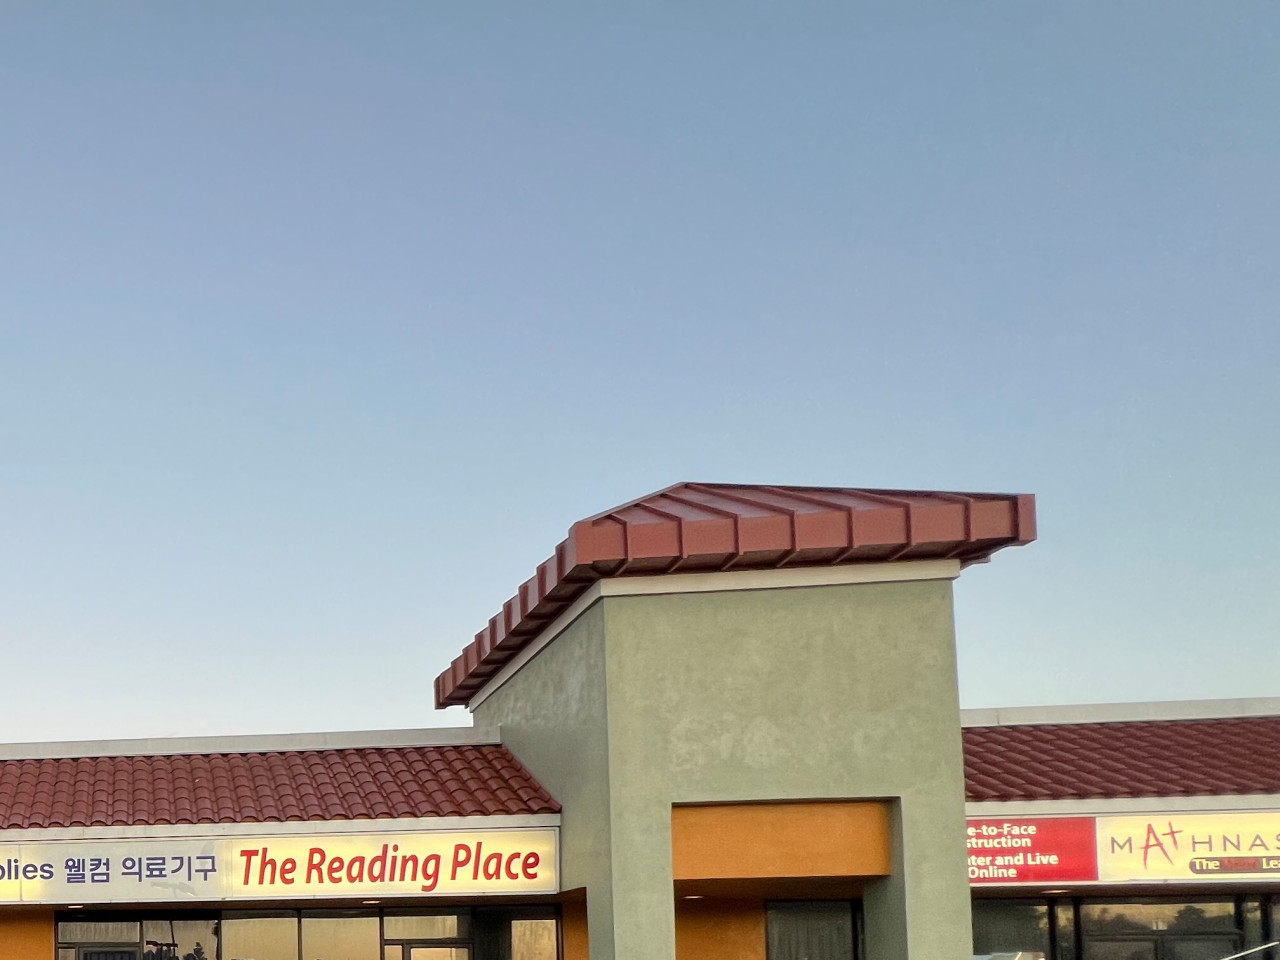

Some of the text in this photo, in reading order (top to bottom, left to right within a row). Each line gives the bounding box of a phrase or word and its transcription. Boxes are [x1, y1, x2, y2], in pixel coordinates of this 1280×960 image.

[995, 853, 1024, 865] and
[1027, 853, 1059, 865] Live
[1193, 859, 1220, 870] The
[64, 855, 217, 884] 웰컴 의료기구
[239, 841, 540, 892] The Reading Place
[968, 866, 1017, 878] Online
